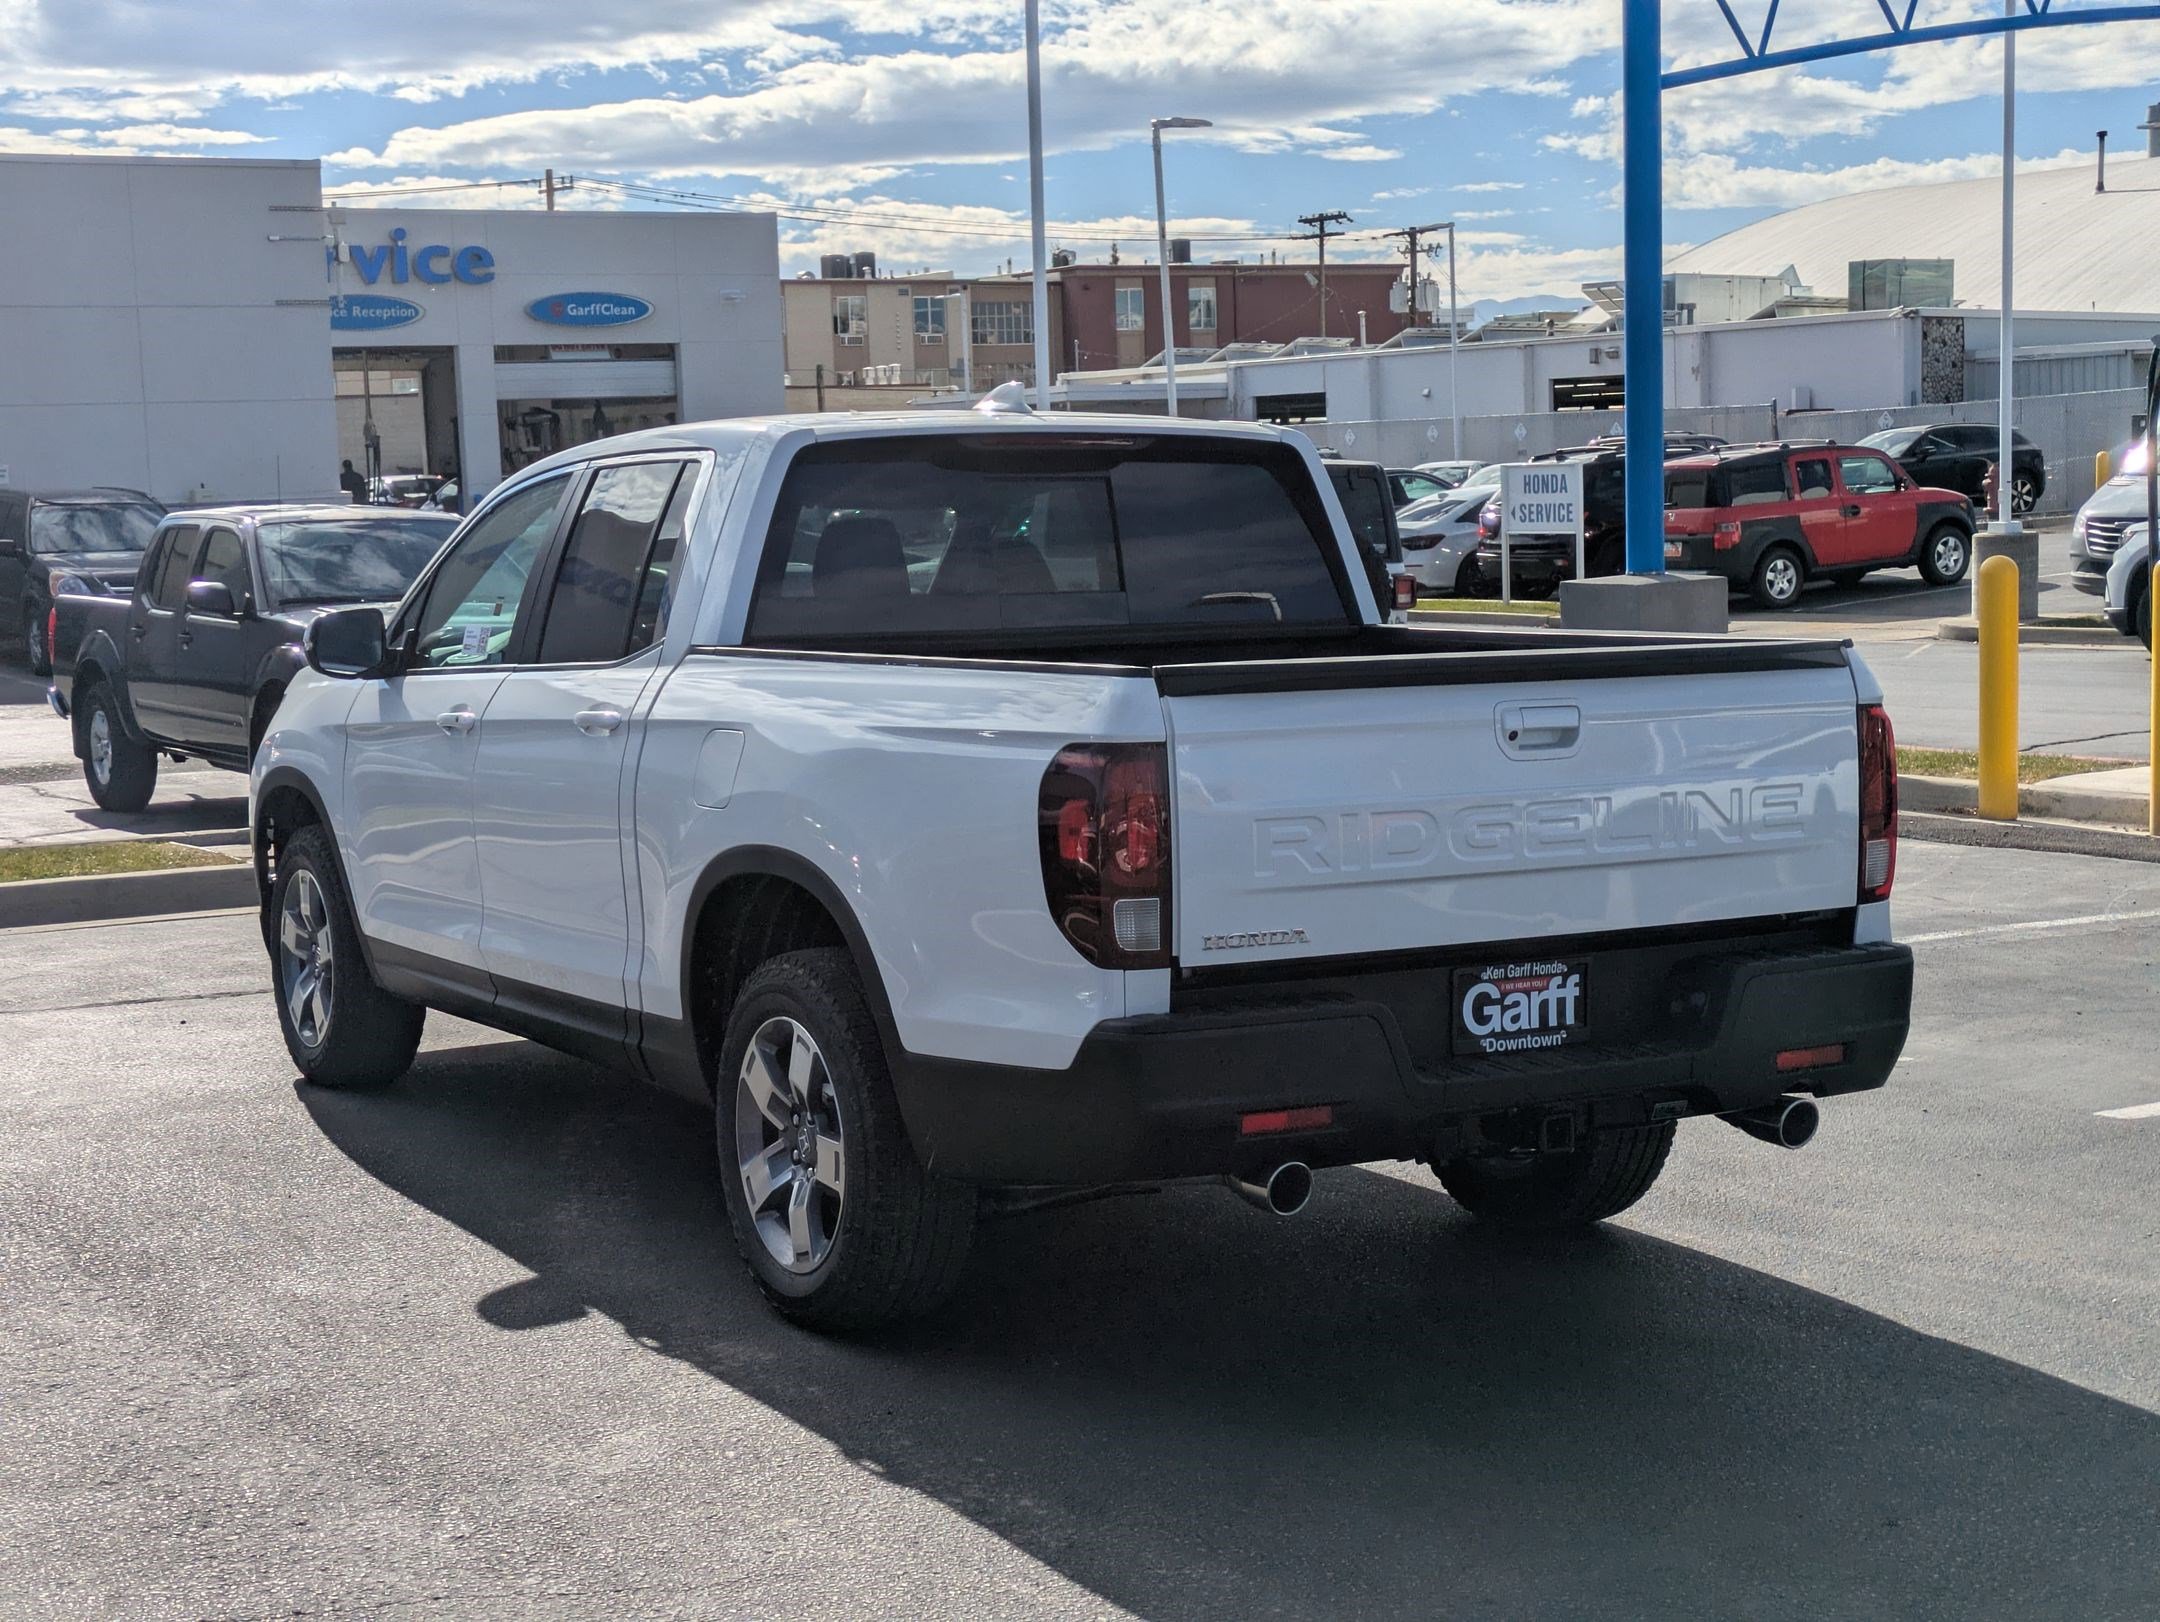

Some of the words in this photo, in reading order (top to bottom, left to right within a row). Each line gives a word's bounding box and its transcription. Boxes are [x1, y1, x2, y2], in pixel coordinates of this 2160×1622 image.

[352, 305, 415, 320] Reception
[567, 303, 636, 316] GarffClean
[1523, 474, 1568, 494] HONDA
[1519, 503, 1574, 523] SERVICE
[1252, 783, 1804, 878] RIDGELINE
[1202, 928, 1311, 951] HONDA
[1486, 966, 1504, 980] Ken
[1507, 964, 1530, 978] Garff
[1533, 961, 1562, 975] Honda
[1462, 974, 1580, 1036] Garff
[1486, 1034, 1562, 1053] Downtown
